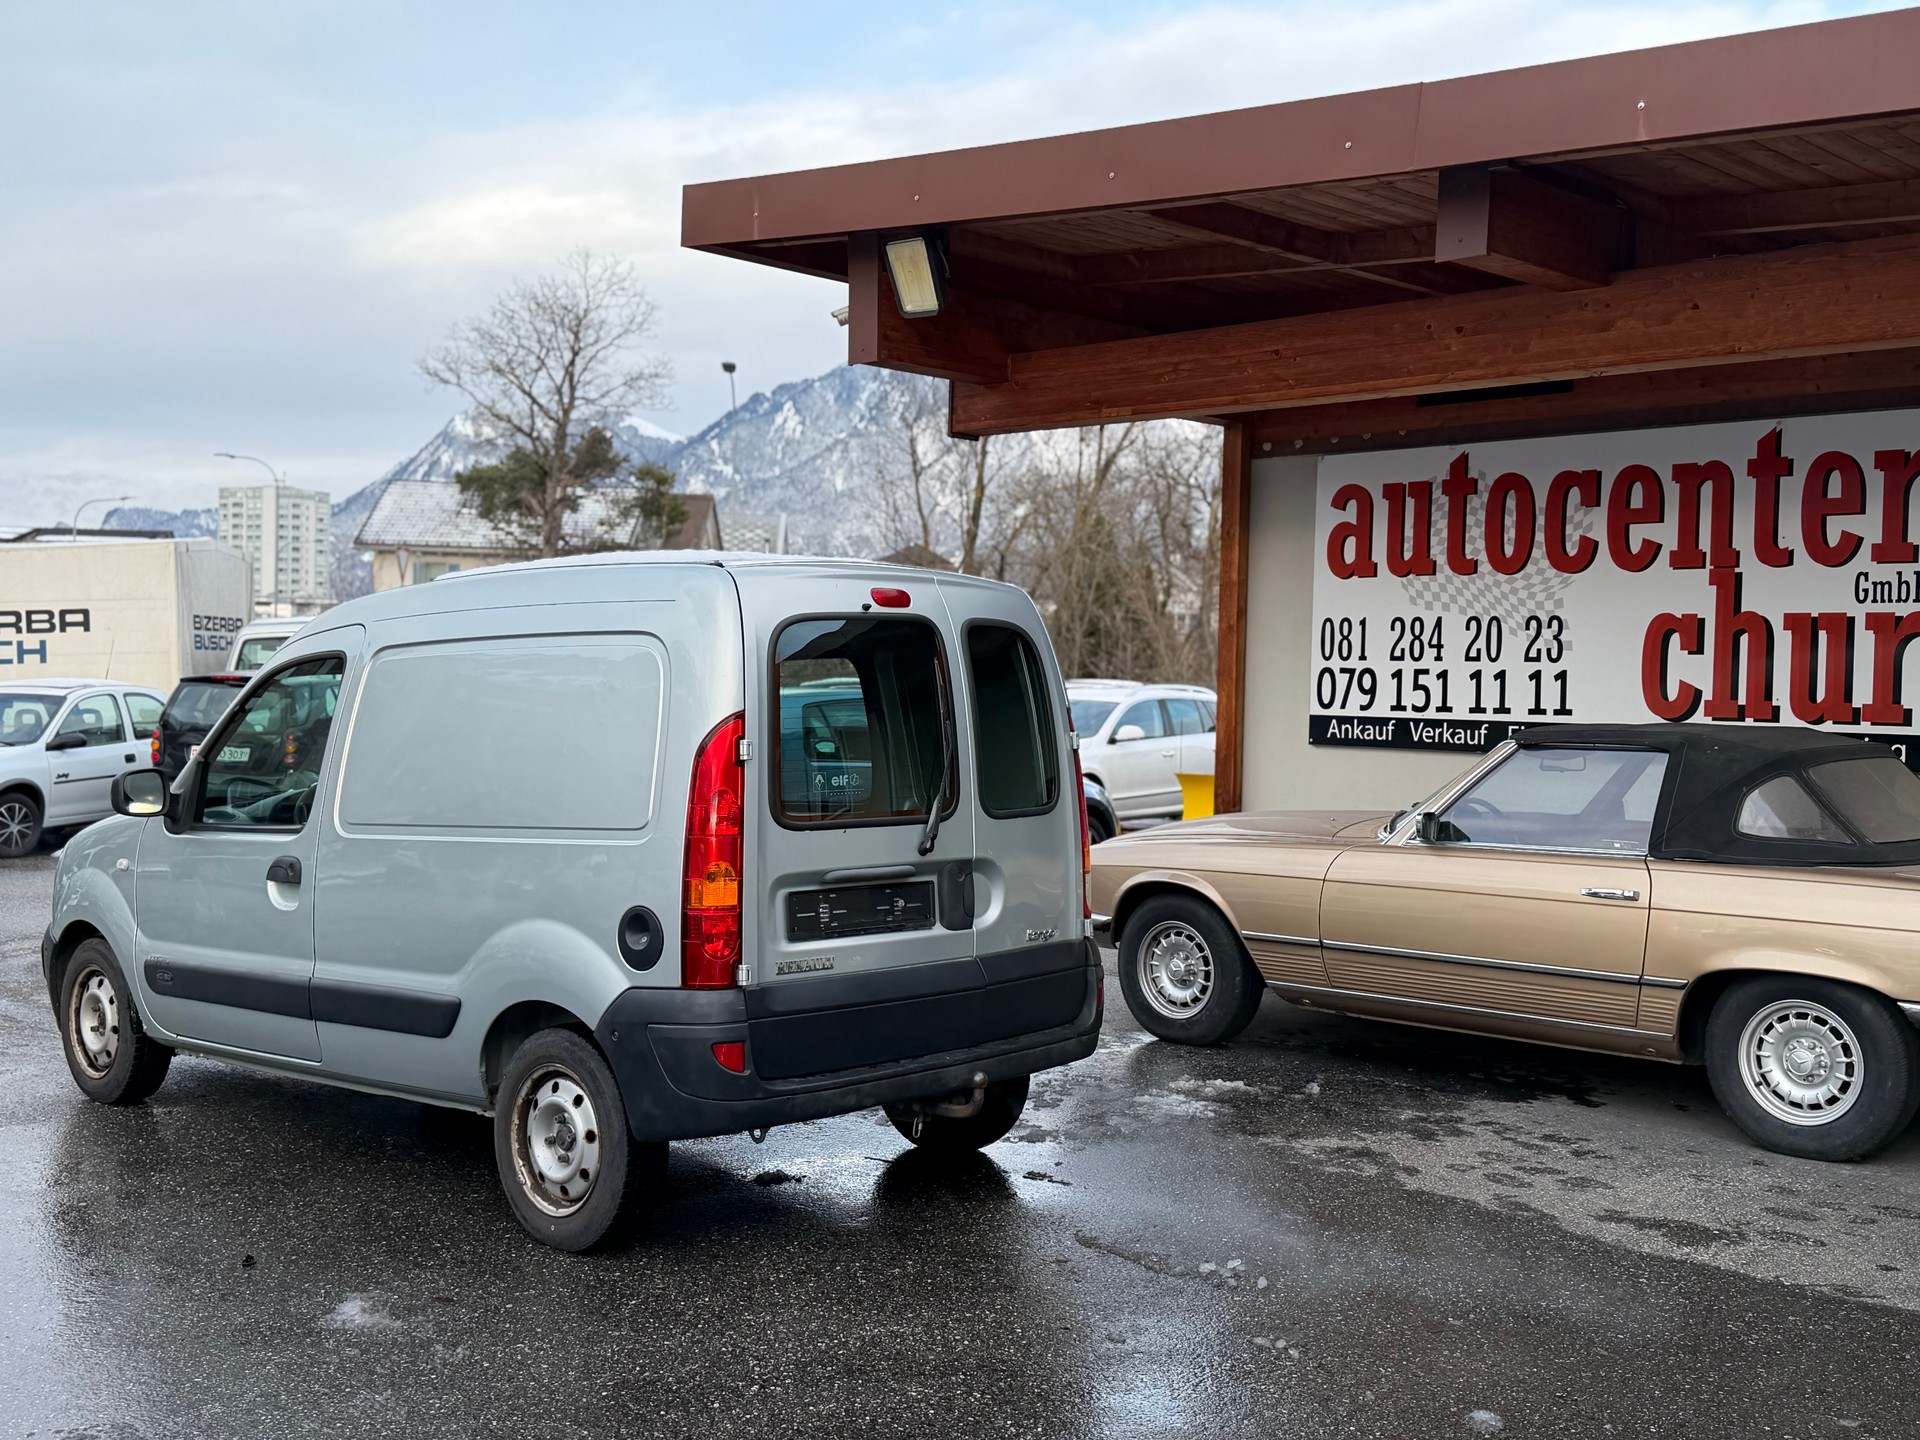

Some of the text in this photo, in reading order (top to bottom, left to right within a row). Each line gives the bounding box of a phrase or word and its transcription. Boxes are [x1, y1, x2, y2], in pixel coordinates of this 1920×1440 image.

[1326, 427, 1920, 580] autocenter
[194, 633, 234, 651] BUSCH
[1320, 615, 1564, 664] 081 284 20 23
[1641, 567, 1920, 727] chur
[1316, 667, 1573, 716] 079 151 11 11
[1326, 718, 1396, 742] Ankauf
[1409, 720, 1489, 745] Verkauf
[831, 774, 849, 786] elf
